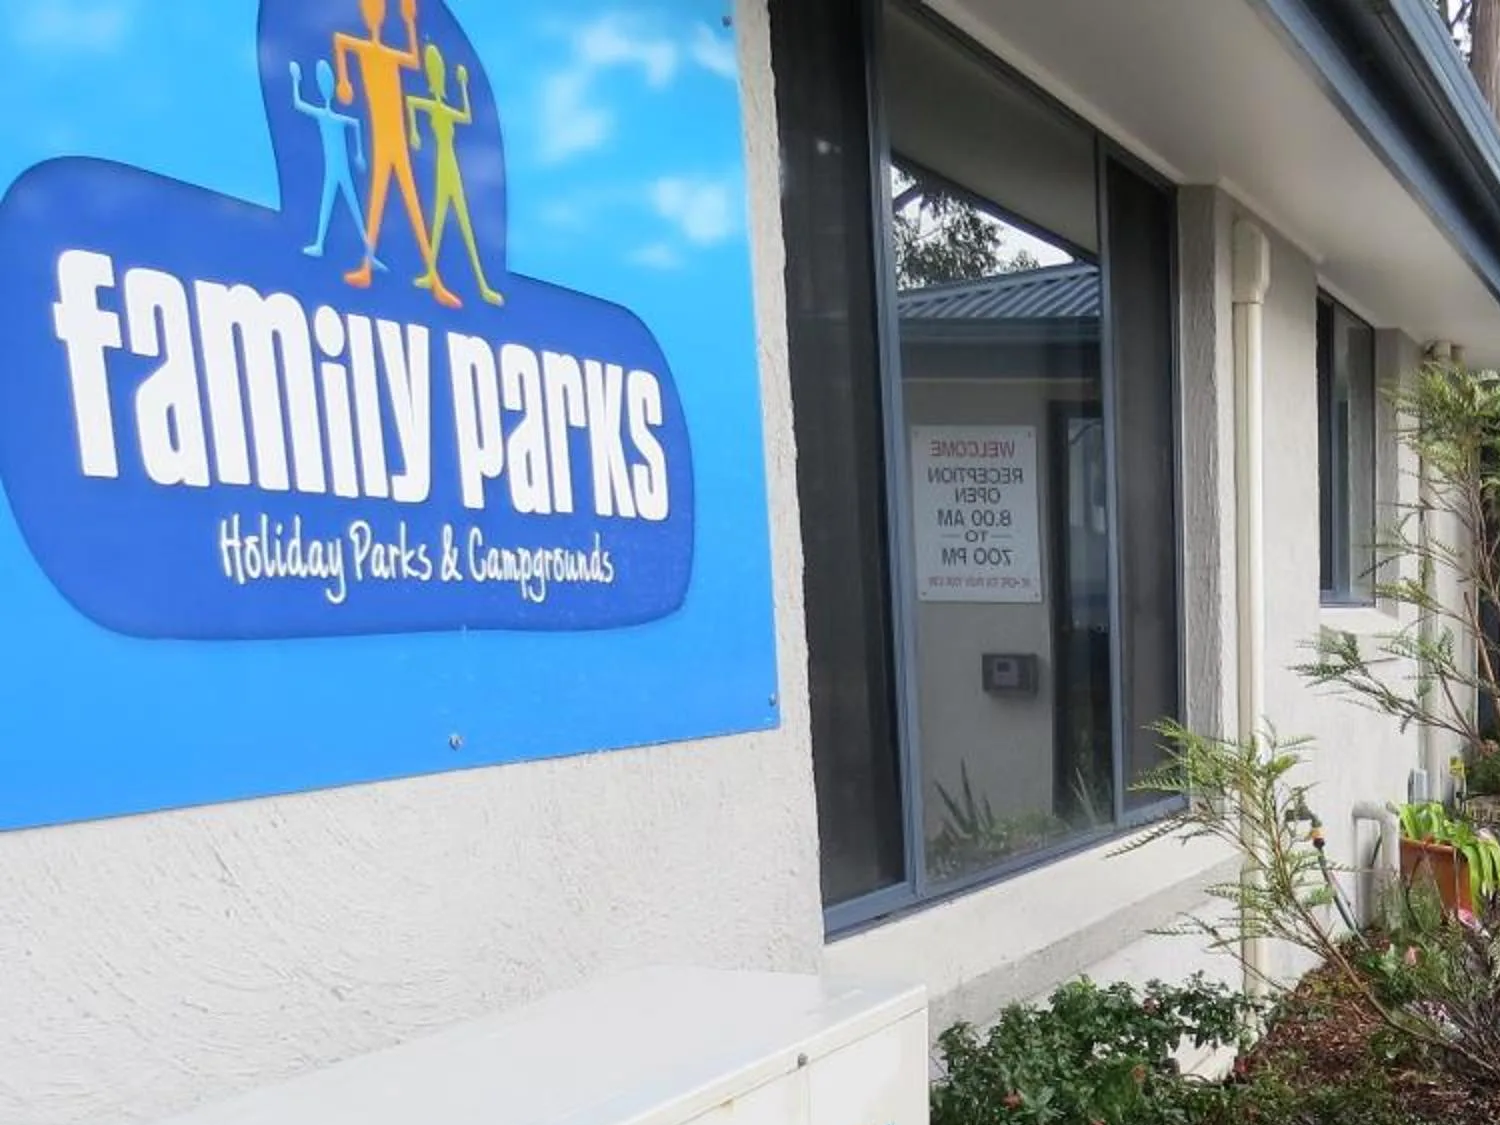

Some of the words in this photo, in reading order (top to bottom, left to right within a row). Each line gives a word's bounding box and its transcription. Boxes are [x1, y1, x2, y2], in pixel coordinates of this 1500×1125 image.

[53, 249, 431, 503] family
[447, 331, 670, 521] parks
[219, 513, 346, 604] Holiday
[349, 520, 431, 582] Parks
[440, 523, 463, 582] &
[468, 531, 615, 602] Campgrounds
